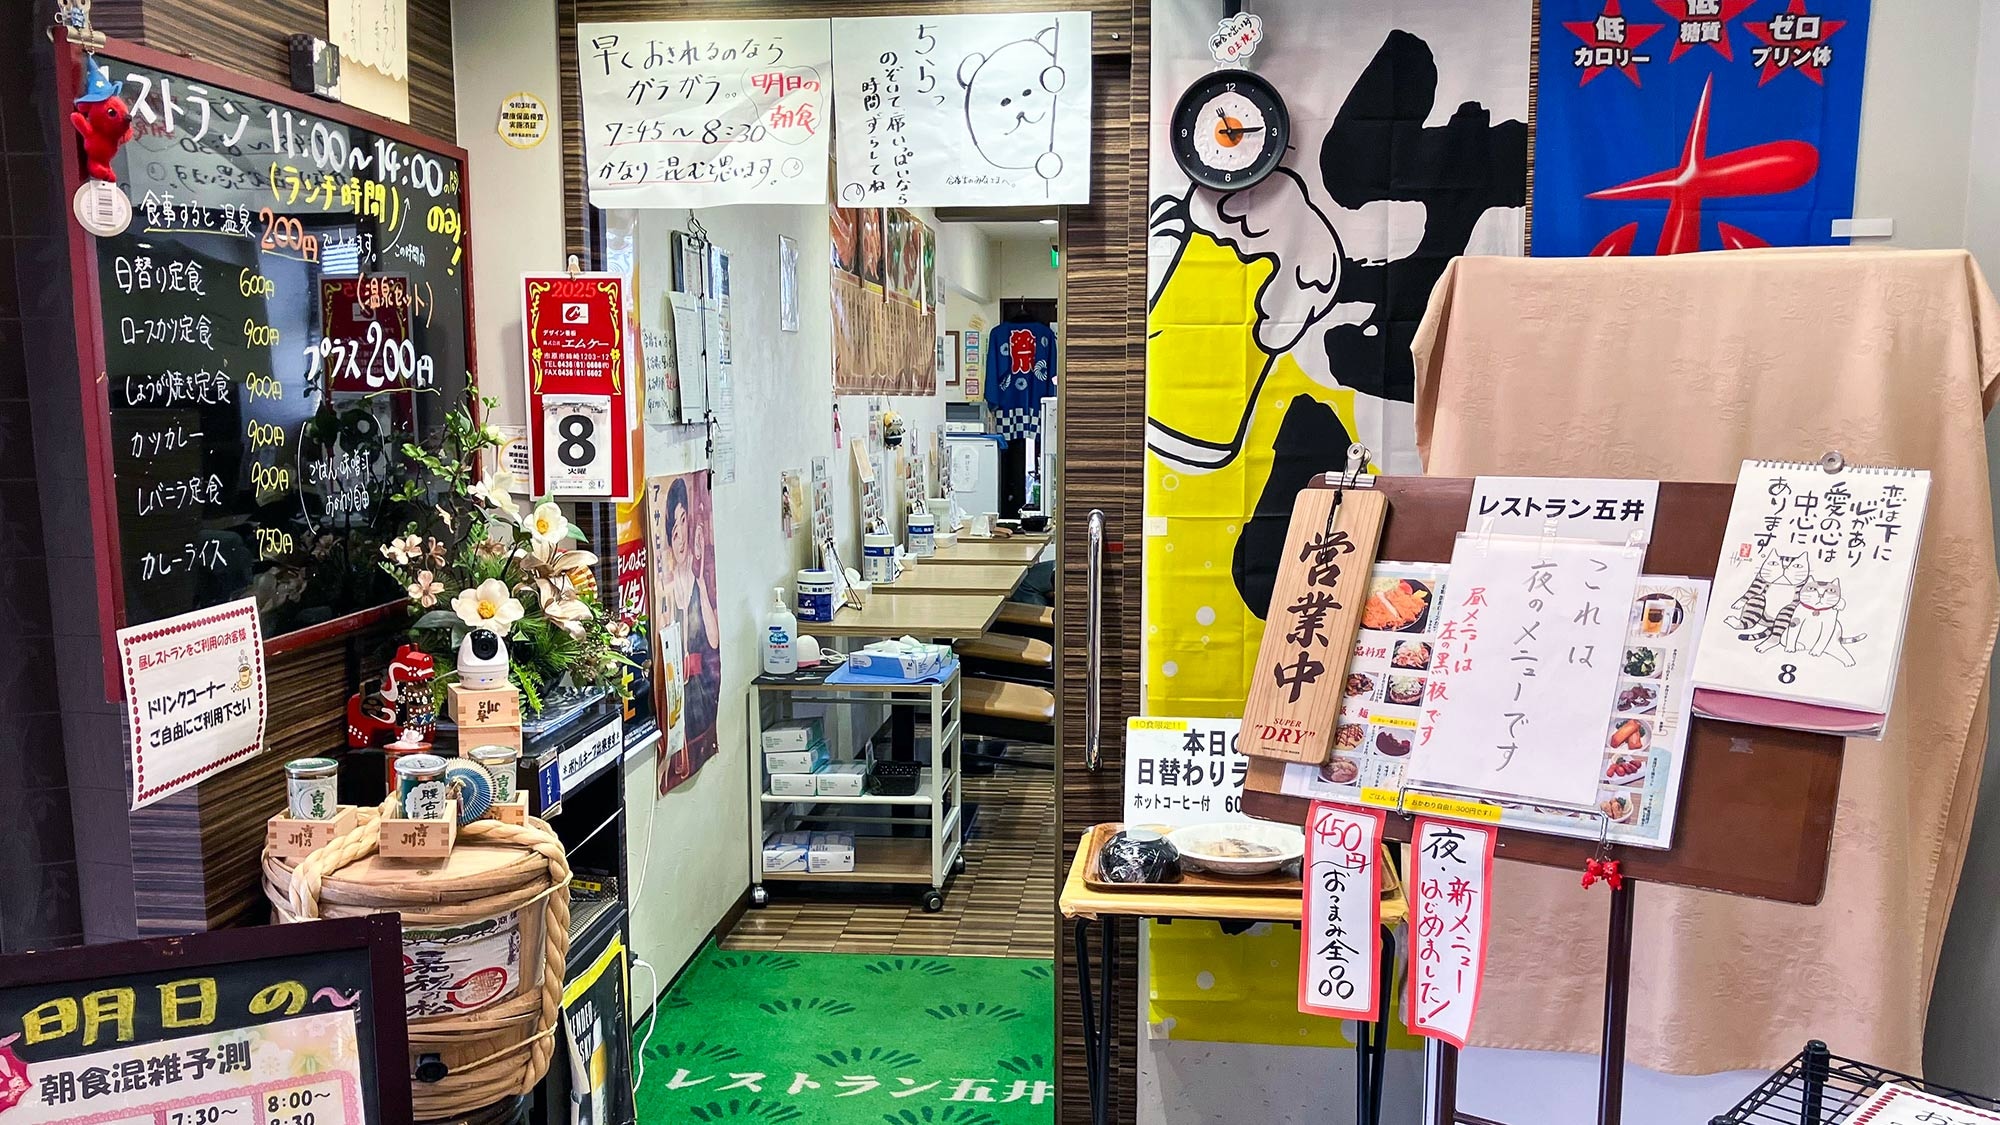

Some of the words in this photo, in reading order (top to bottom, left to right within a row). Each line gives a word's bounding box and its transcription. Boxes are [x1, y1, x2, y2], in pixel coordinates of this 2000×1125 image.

[1595, 15, 1626, 44] 低
[1680, 21, 1721, 43] 糖質
[1769, 15, 1820, 41] ゼロ
[1574, 48, 1650, 68] カロリー
[1752, 47, 1832, 68] プリン体
[751, 72, 820, 98] 明日の
[1225, 83, 1236, 92] 12
[100, 66, 250, 147] ストラン
[769, 102, 815, 135] 朝食
[1181, 129, 1188, 138] 9
[1271, 127, 1278, 137] 3
[1224, 173, 1232, 182] 6
[115, 255, 206, 296] 日替り定食
[239, 267, 276, 300] 600円
[551, 281, 597, 299] 2025
[121, 314, 214, 351] ロースカツ定食
[243, 318, 280, 350] 900円
[126, 368, 231, 407] しょうが焼き定食
[245, 372, 283, 404] 900円
[131, 426, 205, 458] カツカレー
[247, 419, 286, 453] 900円
[557, 414, 596, 468] 8
[251, 461, 290, 498] 900円
[568, 467, 587, 475] 火曜
[1478, 495, 1646, 522] レストラン五井
[1790, 490, 1819, 545] 中心に
[1812, 481, 1852, 563] 愛の心は
[1873, 485, 1907, 561] 恋は下に
[1846, 500, 1878, 568] 心があり
[141, 539, 228, 582] カレーライス
[255, 528, 294, 562] 750円
[1273, 531, 1356, 704] 営業中
[1454, 586, 1488, 673] 昼メニューは
[1567, 558, 1608, 669] これは
[138, 627, 247, 672] 昼レストランをご利用のお客様
[1495, 559, 1559, 772] 夜のメニューです
[1420, 620, 1459, 746] 左の黒板です
[1777, 664, 1798, 684] 8
[148, 680, 226, 720] ドリンクコーナー
[150, 697, 252, 749] ご自由にご利用下さい
[1273, 718, 1302, 728] SUPER
[1134, 793, 1211, 812] ホットコーヒー付
[1447, 875, 1478, 994] 新メニュー
[21, 977, 309, 1047] 明日の
[39, 1040, 252, 1106] 朝食混雑予測
[665, 1068, 1054, 1105] レストラン五井
